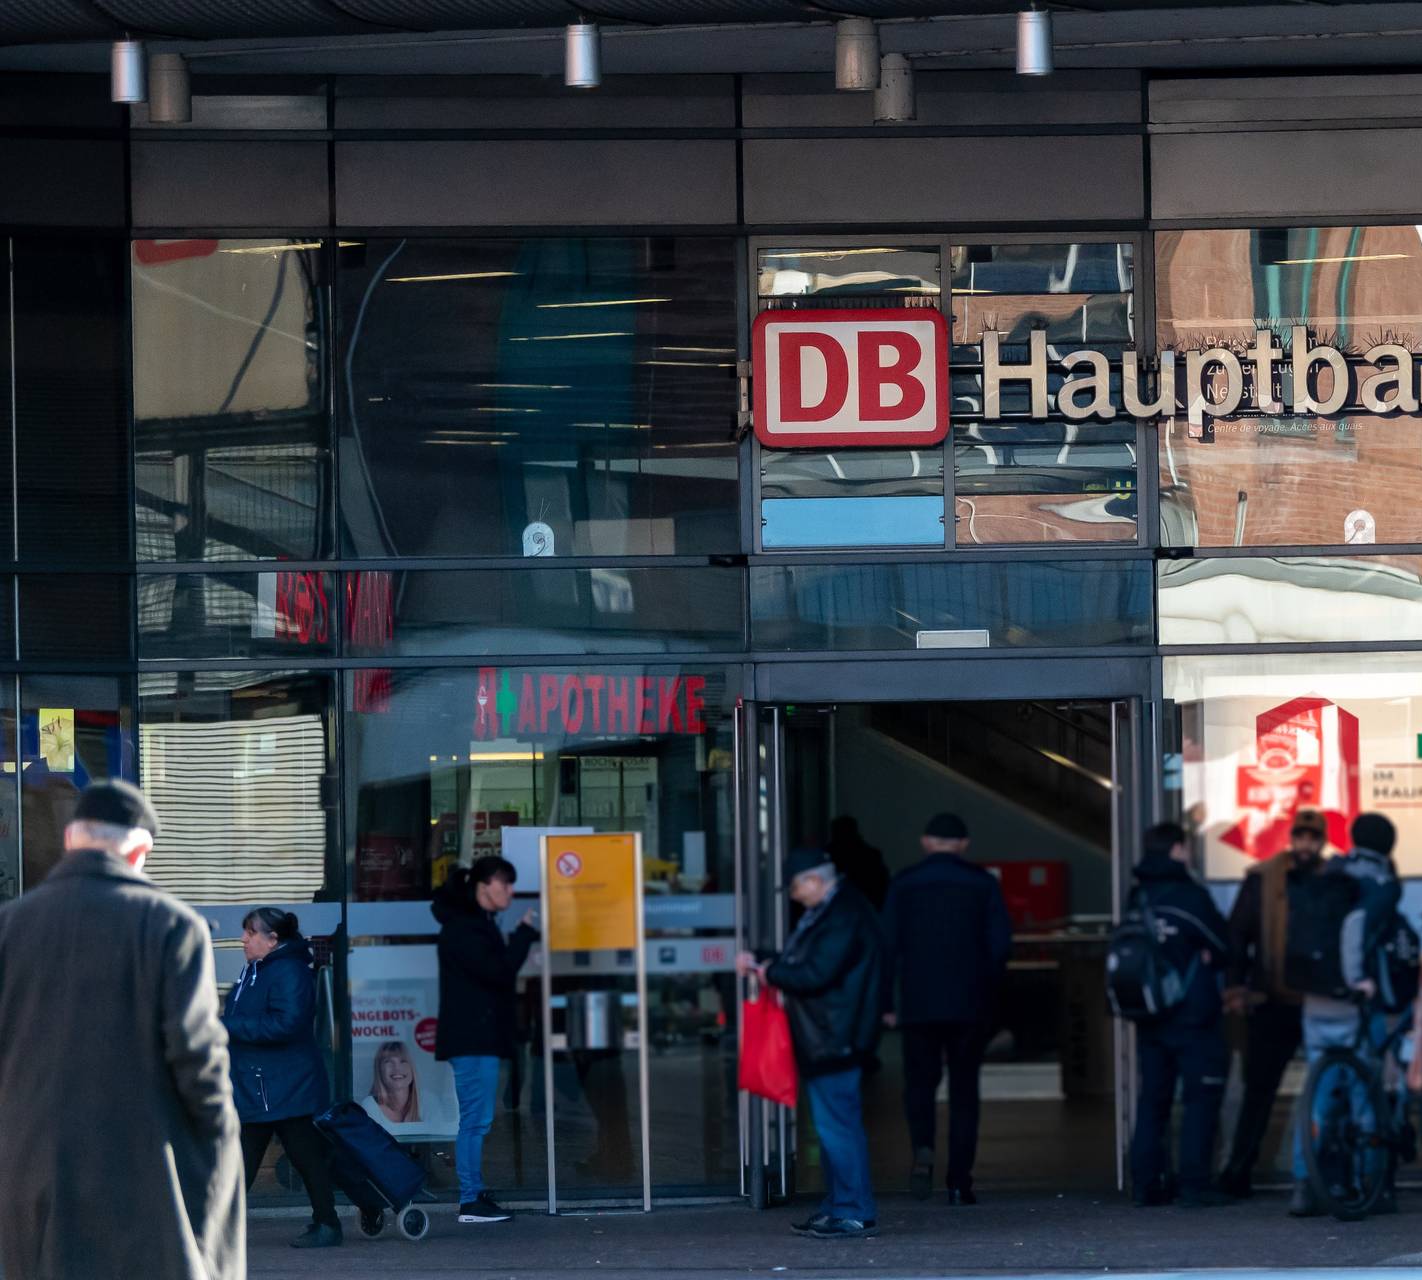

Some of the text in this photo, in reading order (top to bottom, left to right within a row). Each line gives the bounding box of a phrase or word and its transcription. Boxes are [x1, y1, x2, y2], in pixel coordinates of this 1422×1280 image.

[779, 331, 926, 422] DB
[1207, 425, 1238, 434] Centre
[1239, 424, 1250, 433] de
[518, 672, 706, 735] APOTHEKE
[1373, 771, 1394, 781] IM
